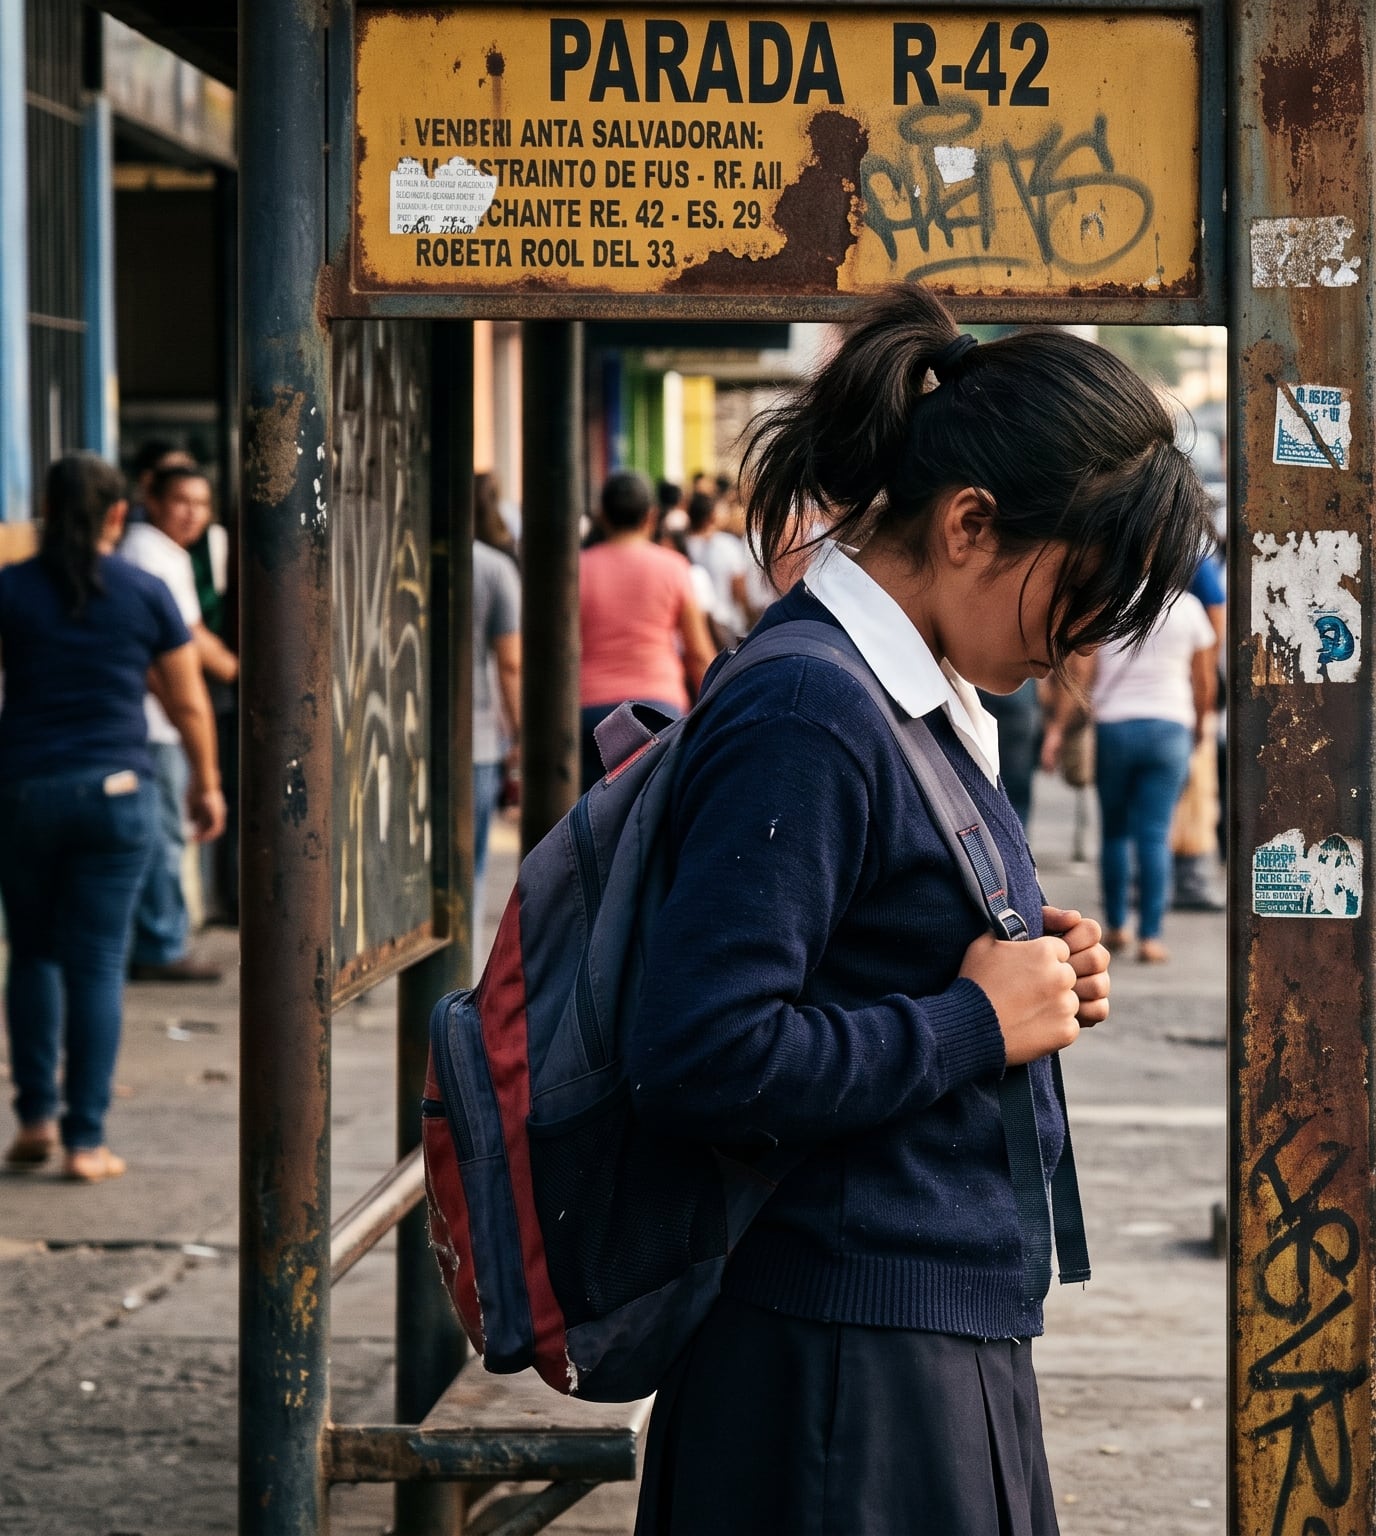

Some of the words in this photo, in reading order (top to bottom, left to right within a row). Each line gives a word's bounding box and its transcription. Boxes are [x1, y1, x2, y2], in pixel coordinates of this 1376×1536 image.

[549, 17, 846, 106] PARADA
[892, 20, 1051, 107] R-42
[519, 118, 585, 149] ANTA
[592, 119, 764, 150] SALVADORAN:
[604, 159, 637, 189] DE
[644, 159, 690, 190] FUS
[589, 198, 628, 229] RE.
[635, 199, 665, 229] 42
[687, 199, 725, 230] ES.
[732, 200, 762, 230] 29
[415, 237, 513, 268] ROBETA
[521, 238, 585, 269] ROOL
[592, 239, 640, 268] DEL
[646, 239, 676, 269] 33
